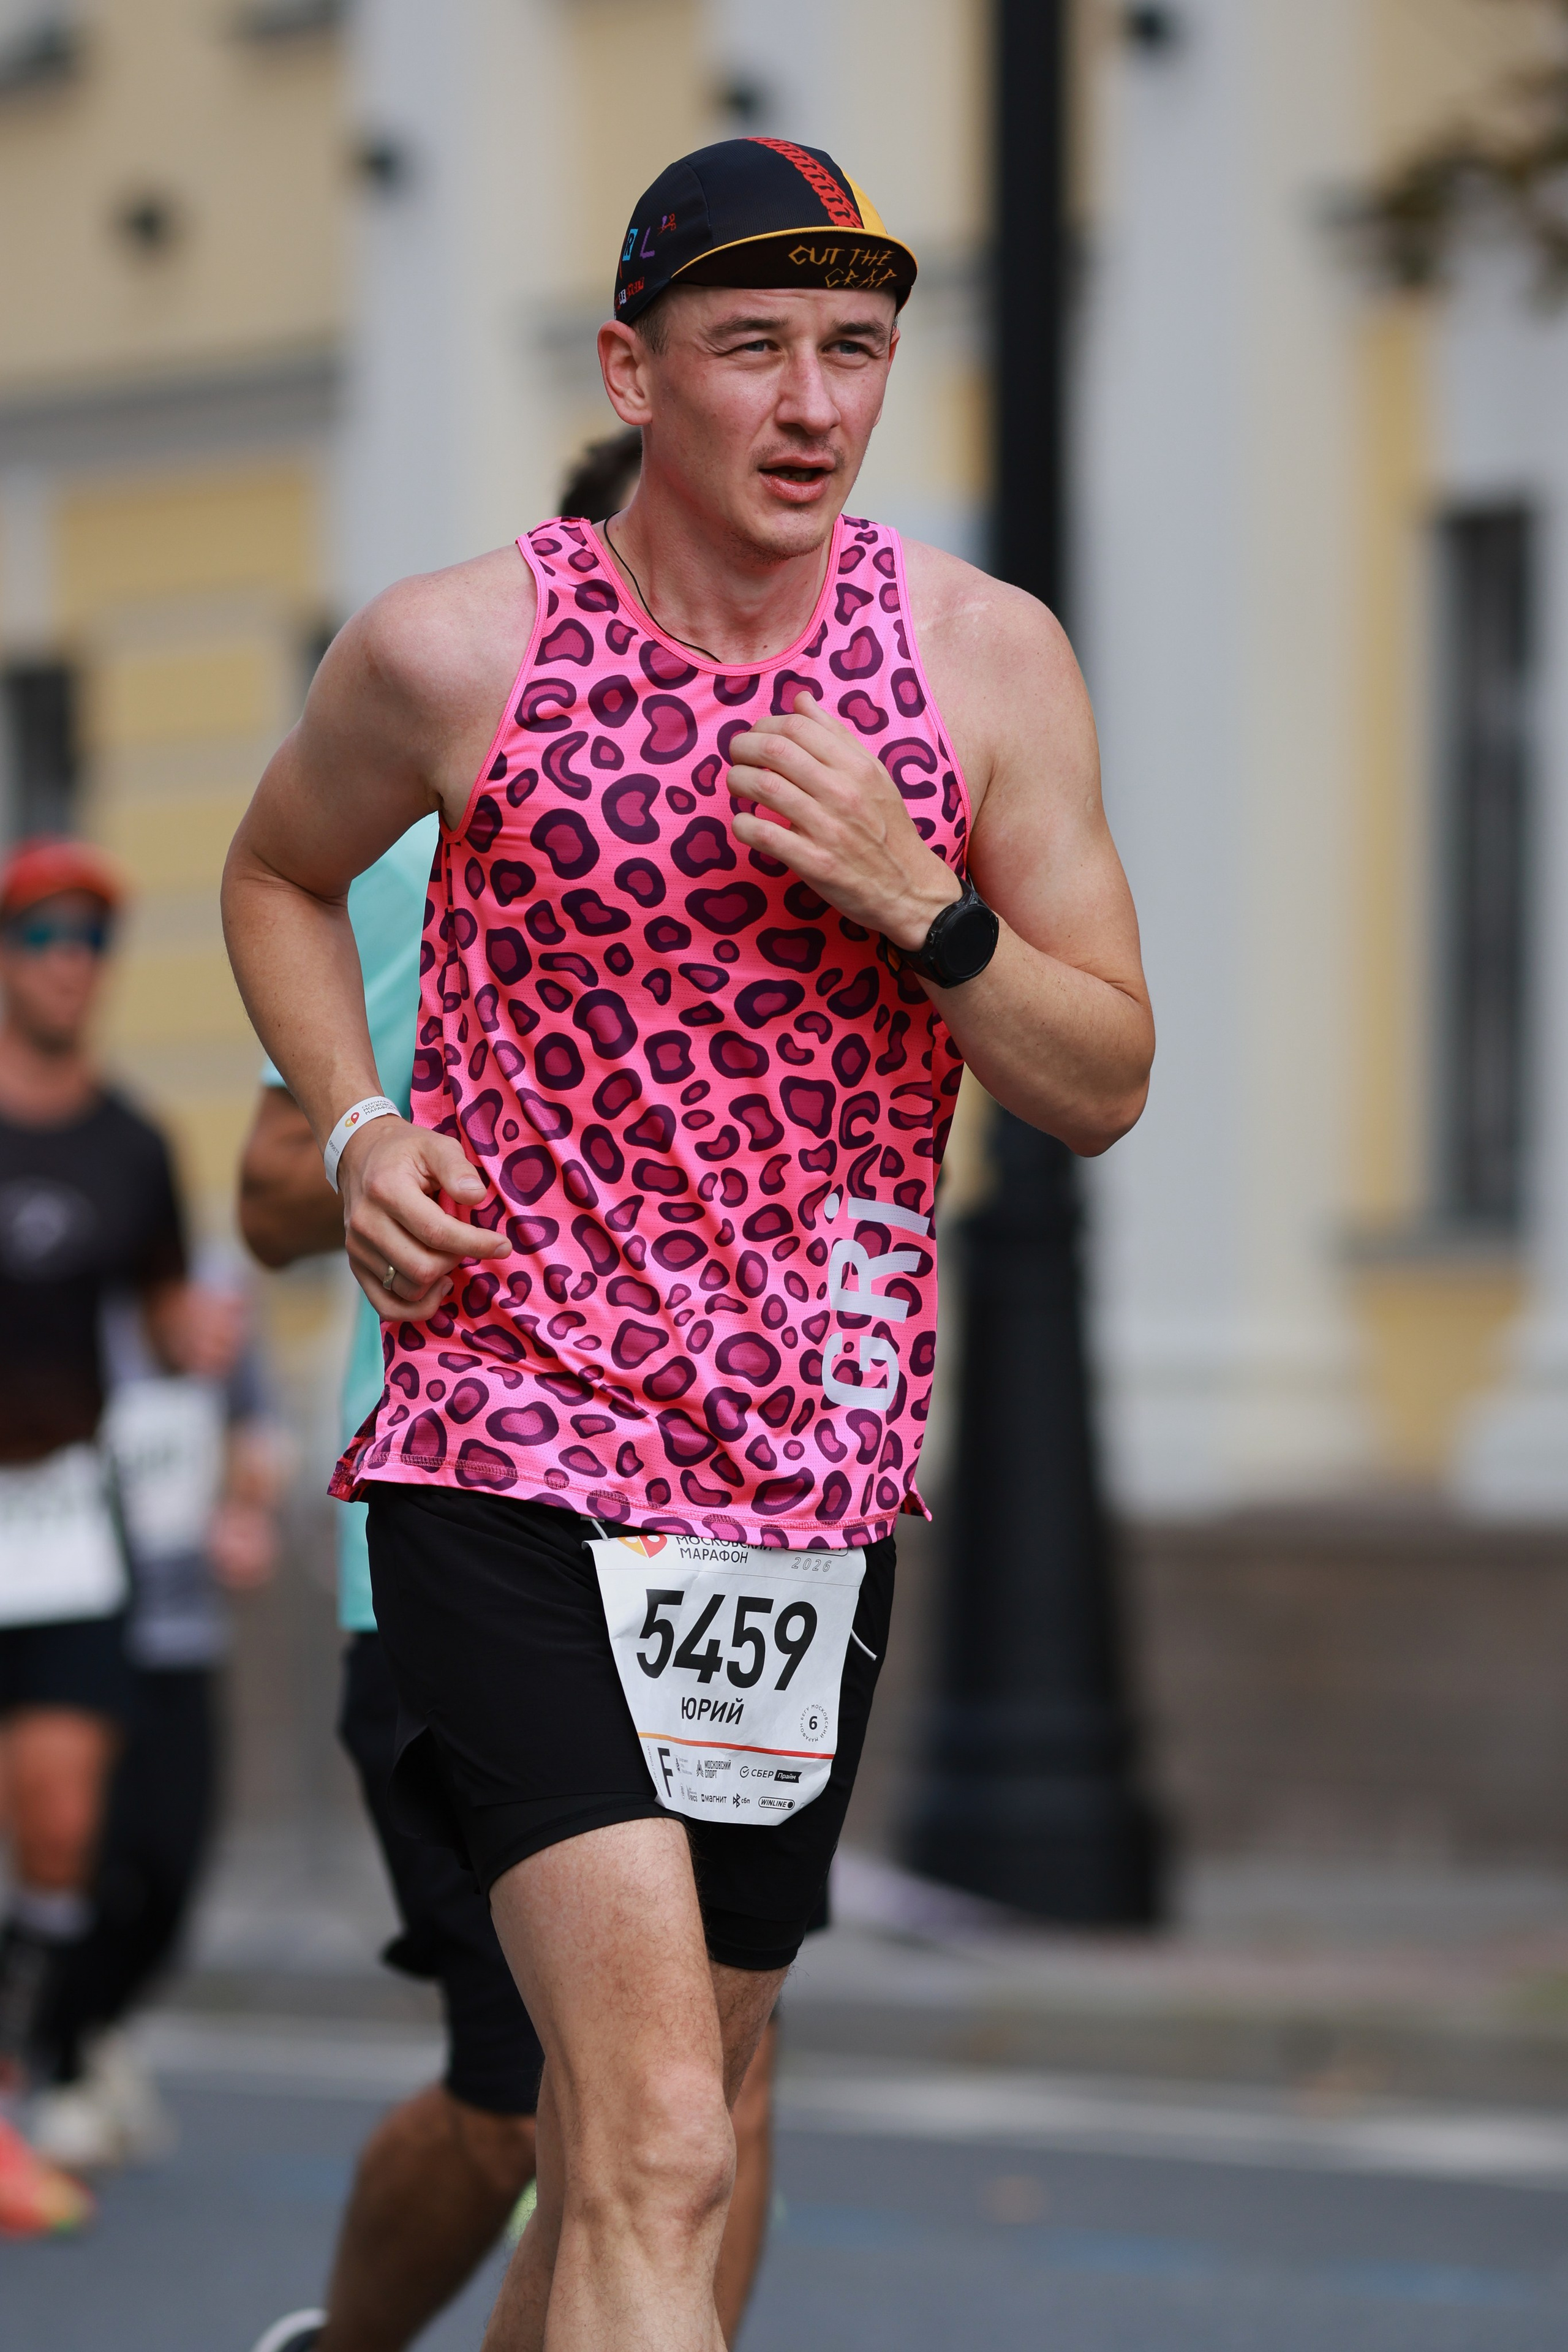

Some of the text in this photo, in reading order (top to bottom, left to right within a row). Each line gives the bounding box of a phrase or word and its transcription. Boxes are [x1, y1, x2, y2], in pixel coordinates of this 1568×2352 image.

[788, 245, 896, 266] CUT THE
[825, 268, 897, 288] CRAP
[675, 1536, 772, 1551] МОСКОВ
[679, 1547, 748, 1564] МАРАФОН
[791, 1556, 832, 1573] 2026
[635, 1588, 819, 1692] 5459
[681, 1697, 745, 1725] ЮРИЙ
[799, 1704, 829, 1743] БЕГУ МОСКОВСКИЙ МАРАФОН
[809, 1715, 818, 1730] 6
[657, 1747, 674, 1798] F
[704, 1759, 731, 1770] МОСКОВСКИЙ
[704, 1770, 717, 1779] СПОРТ
[751, 1769, 796, 1781] СБЕР Прайм
[761, 1799, 787, 1807] WINLINE
